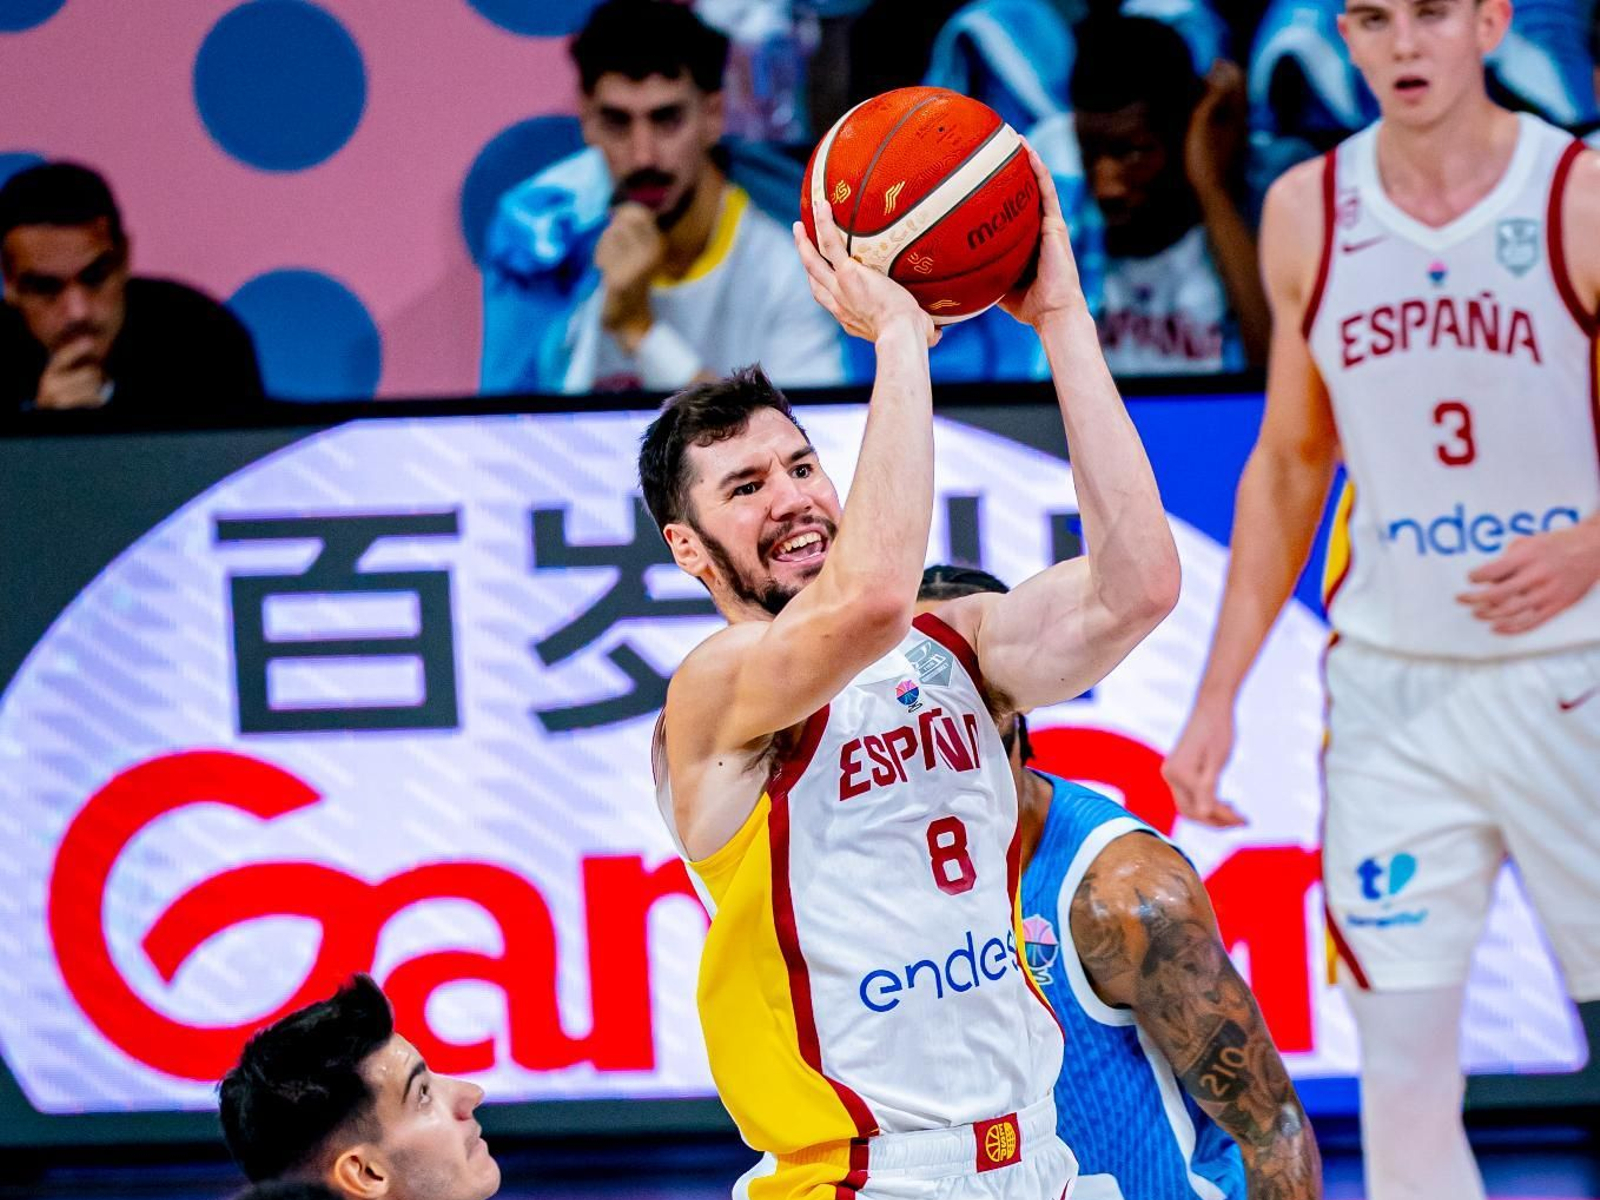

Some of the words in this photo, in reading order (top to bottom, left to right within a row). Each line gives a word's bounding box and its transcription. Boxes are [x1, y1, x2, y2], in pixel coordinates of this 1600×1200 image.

[966, 182, 1035, 251] molten
[1340, 289, 1542, 369] ESPAÑA
[1433, 401, 1476, 467] 3
[1378, 503, 1580, 556] ndesa
[926, 815, 977, 896] 8
[1199, 1046, 1248, 1097] 210
